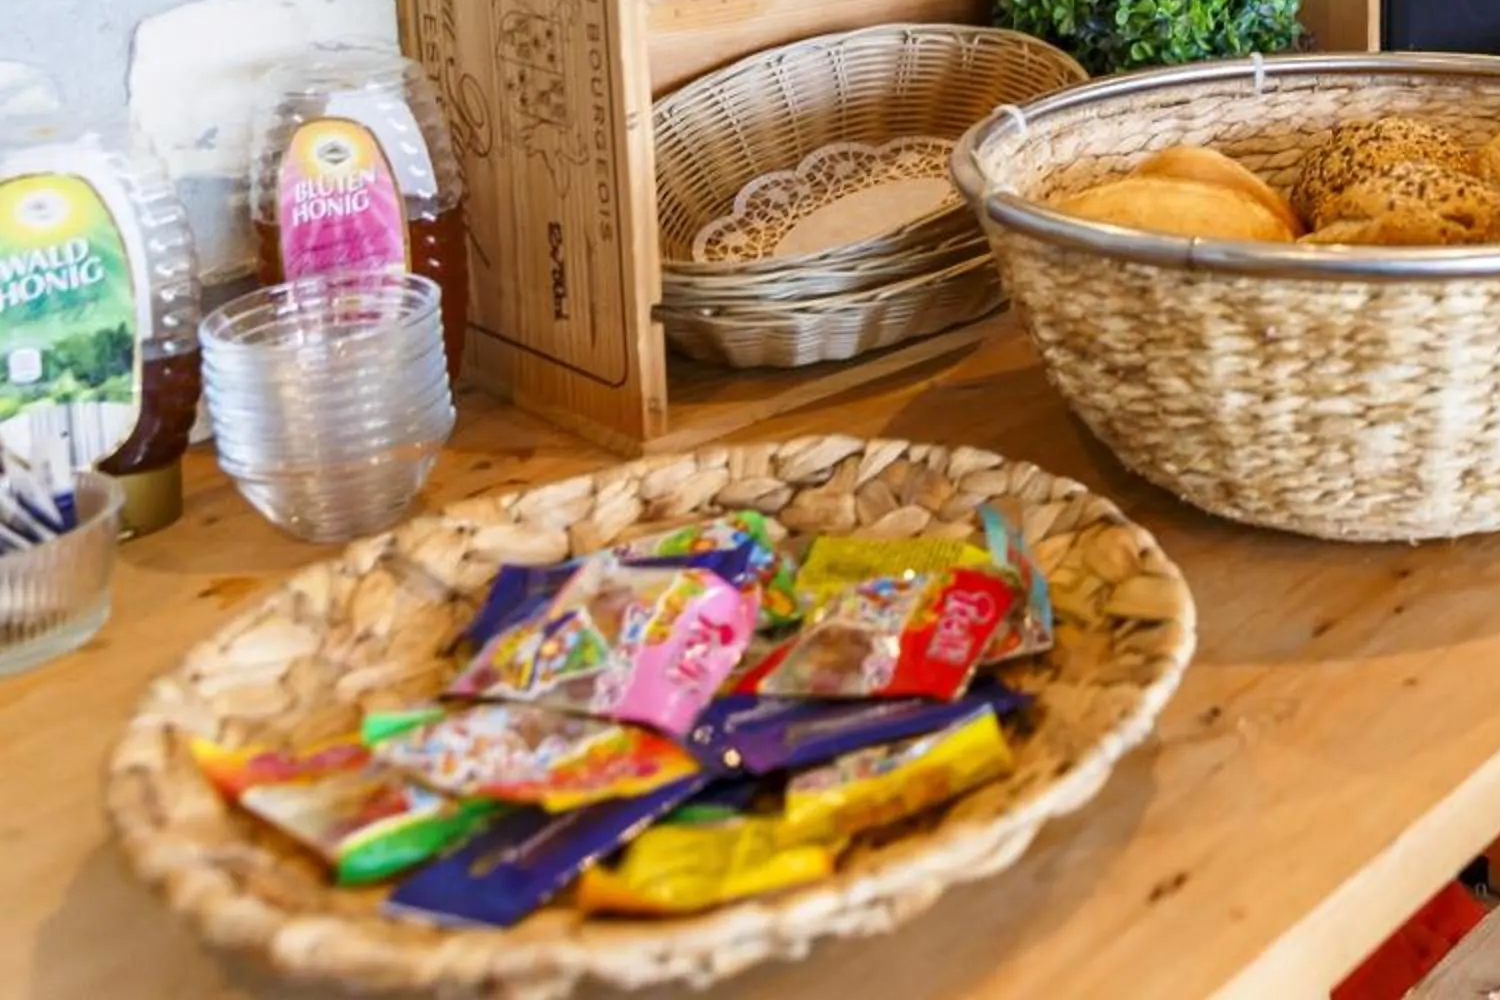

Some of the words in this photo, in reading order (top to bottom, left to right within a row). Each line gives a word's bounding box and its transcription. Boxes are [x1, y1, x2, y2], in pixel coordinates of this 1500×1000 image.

[586, 22, 613, 242] BOURGEOIS
[291, 189, 371, 227] HONIG
[0, 237, 89, 284] WALD
[0, 256, 104, 313] HONIG
